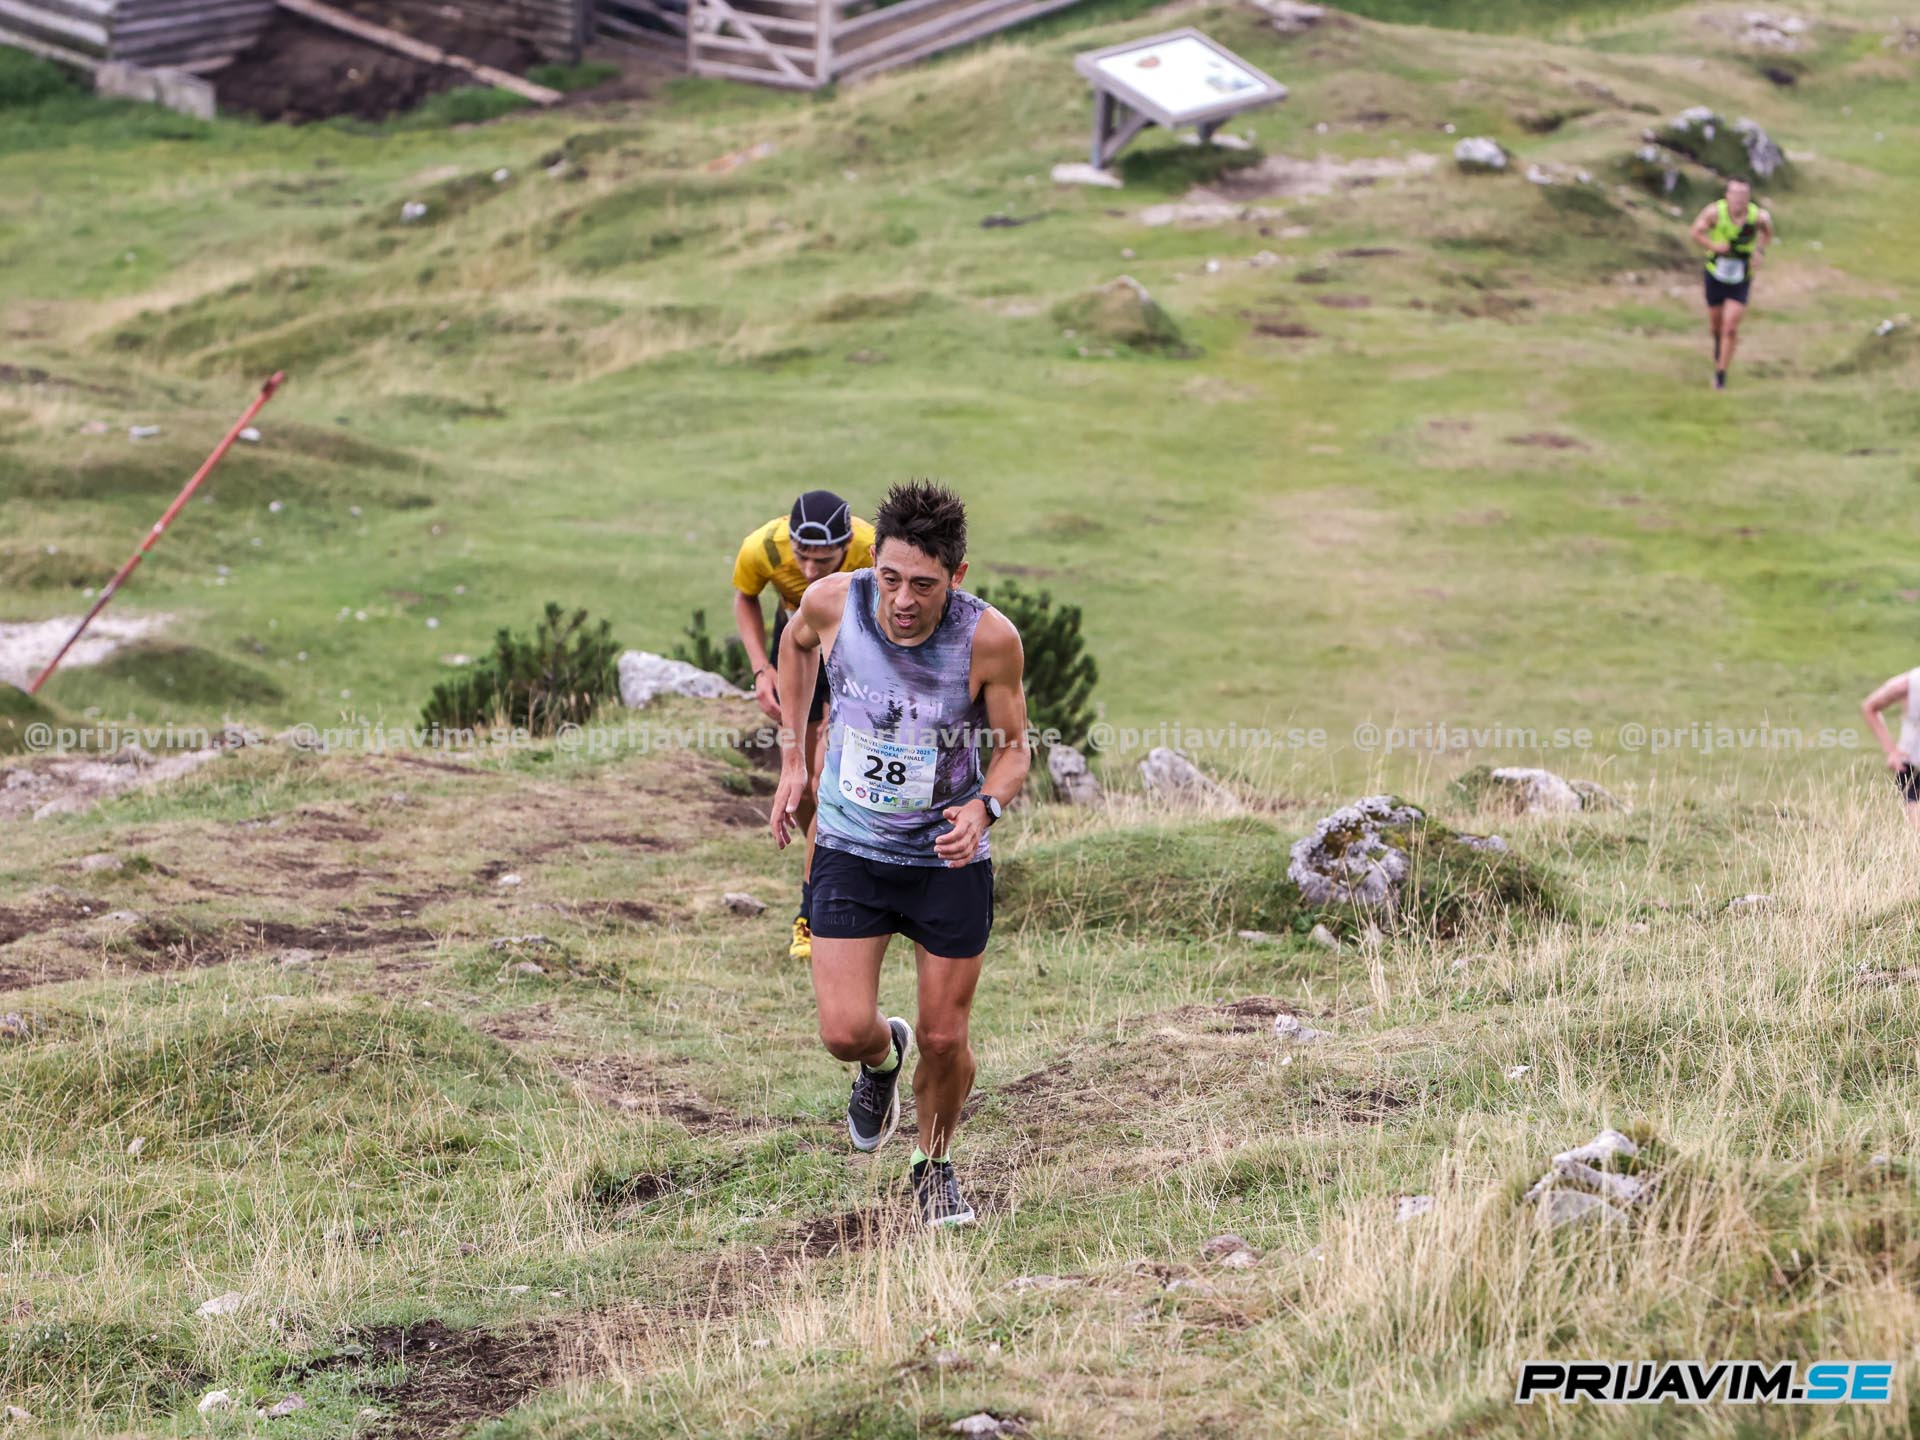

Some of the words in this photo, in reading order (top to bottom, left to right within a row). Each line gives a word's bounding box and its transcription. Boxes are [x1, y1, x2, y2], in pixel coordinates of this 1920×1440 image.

[869, 739, 888, 751] VELO
[888, 745, 916, 755] PLANO
[863, 754, 907, 786] 28
